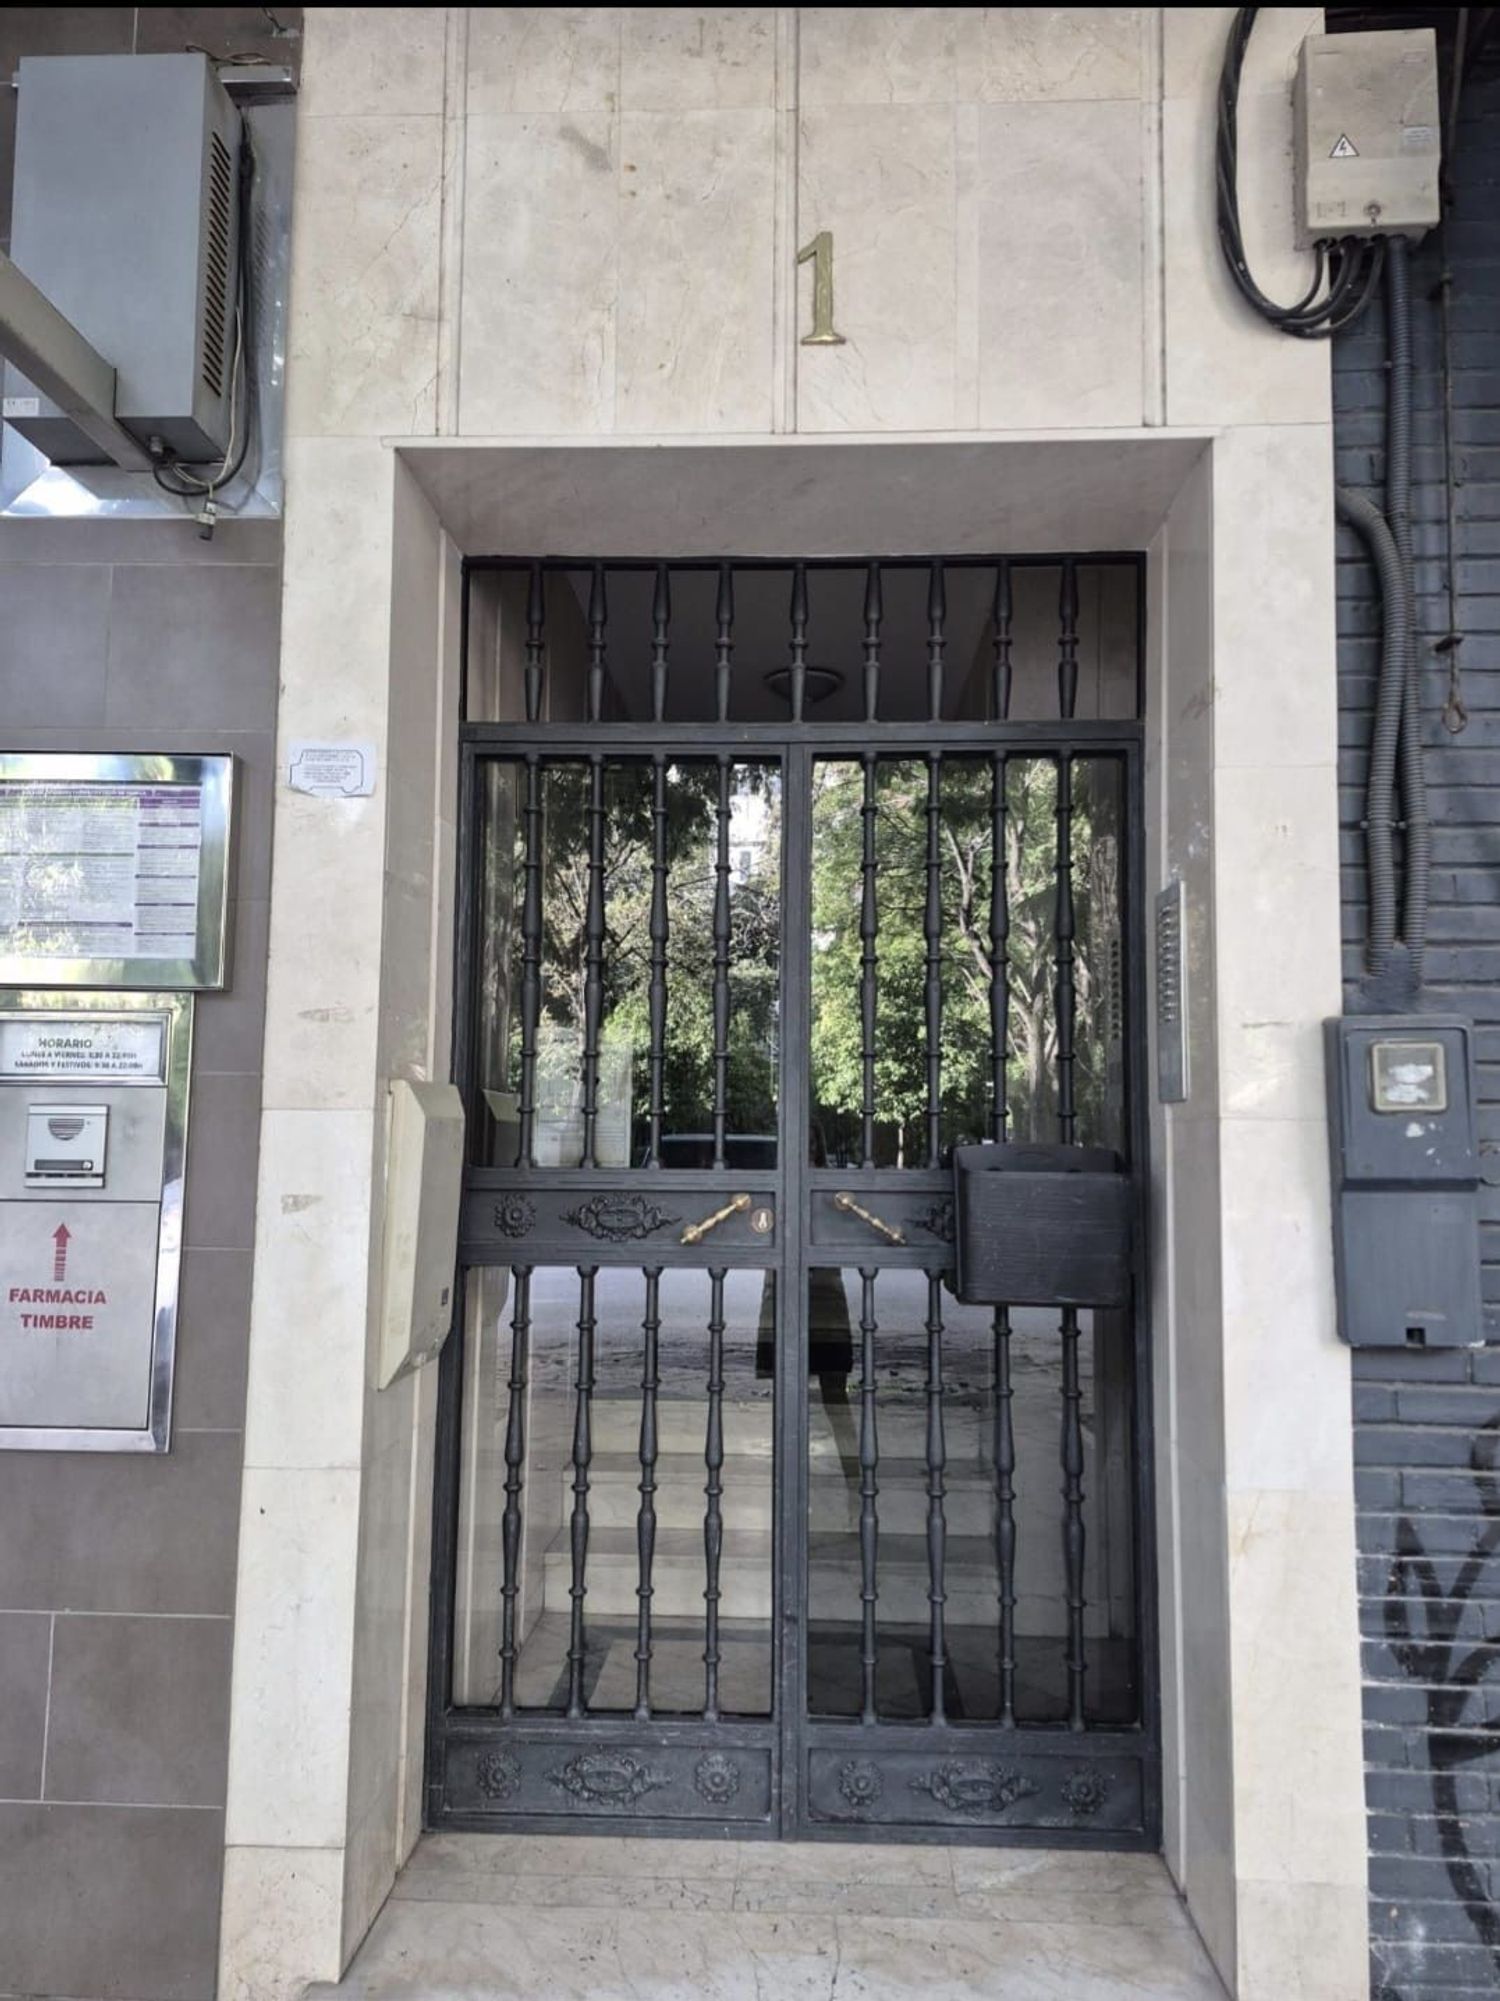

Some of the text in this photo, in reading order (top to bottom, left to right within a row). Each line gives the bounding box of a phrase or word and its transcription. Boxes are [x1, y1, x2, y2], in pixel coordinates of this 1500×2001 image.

[797, 231, 847, 345] 1
[38, 1037, 92, 1049] HORARIO
[9, 1288, 107, 1304] FARMACIA
[20, 1314, 94, 1329] TIMBRE
